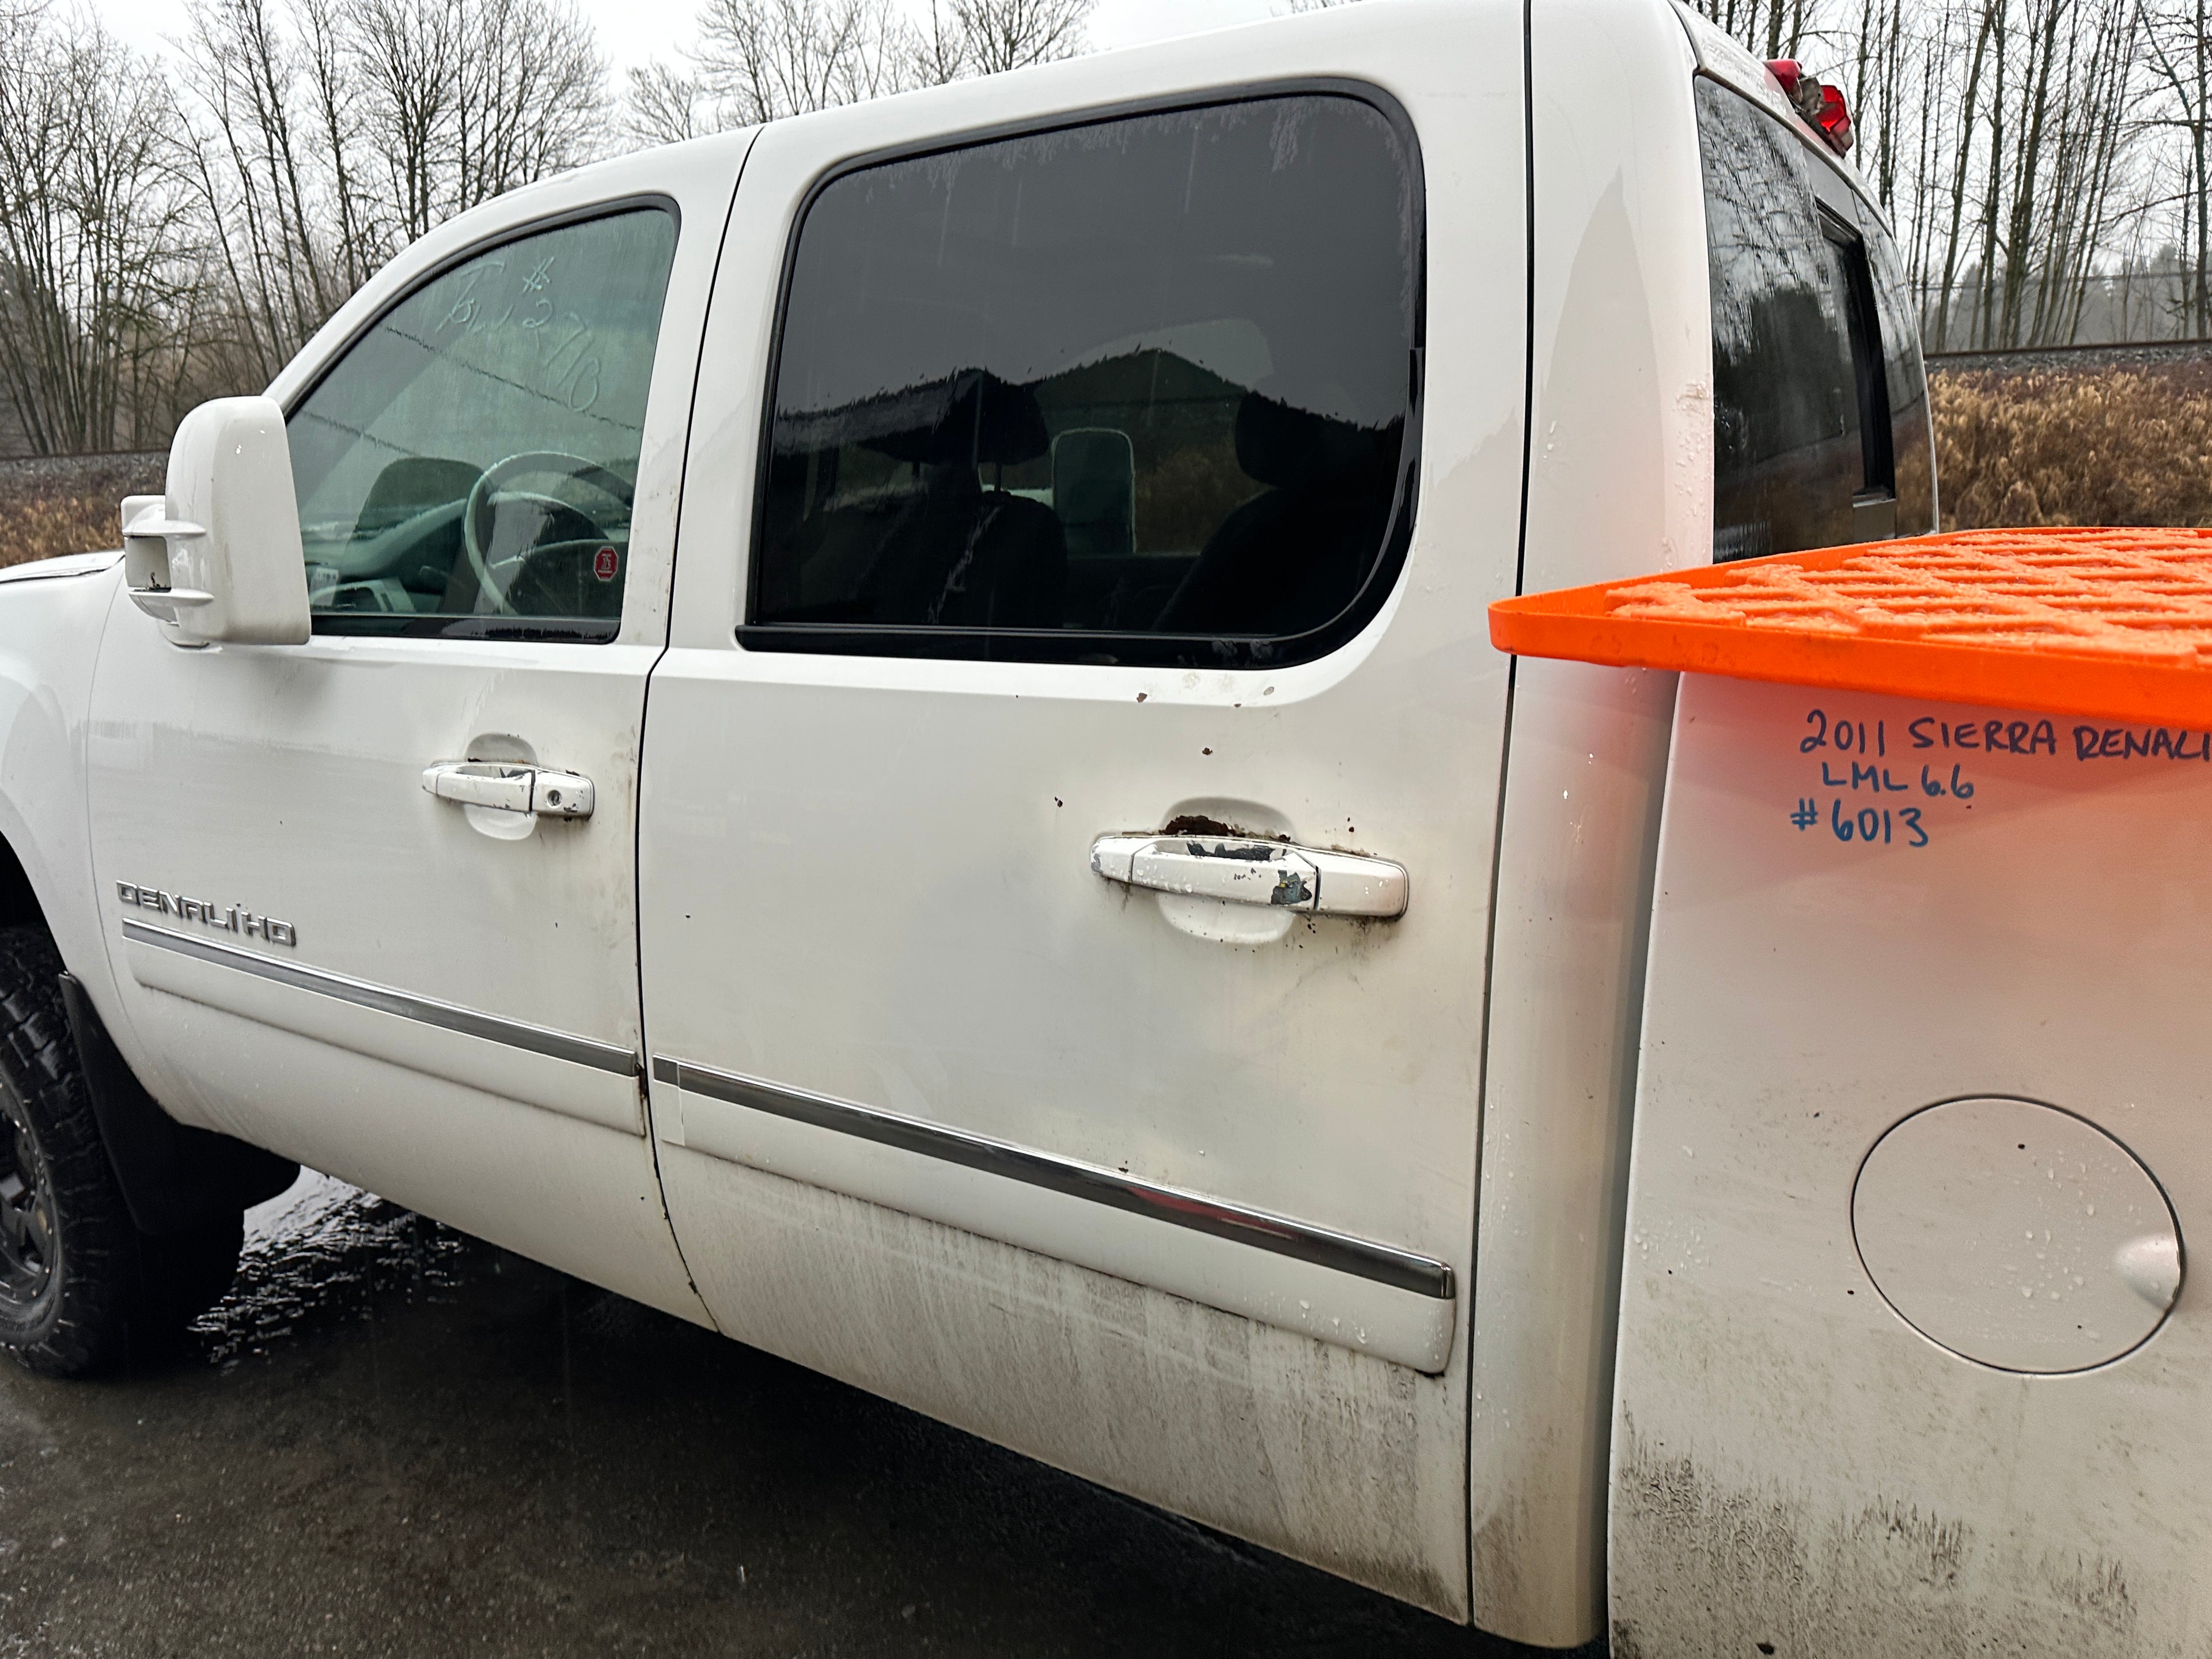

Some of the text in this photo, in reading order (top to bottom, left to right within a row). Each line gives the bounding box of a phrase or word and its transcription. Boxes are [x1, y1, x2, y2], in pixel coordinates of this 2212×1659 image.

[1799, 709, 1885, 757] 2011
[1908, 716, 2057, 756] SIERRA
[1821, 760, 1974, 799] LML 6.6
[116, 879, 297, 947] DENALI HD
